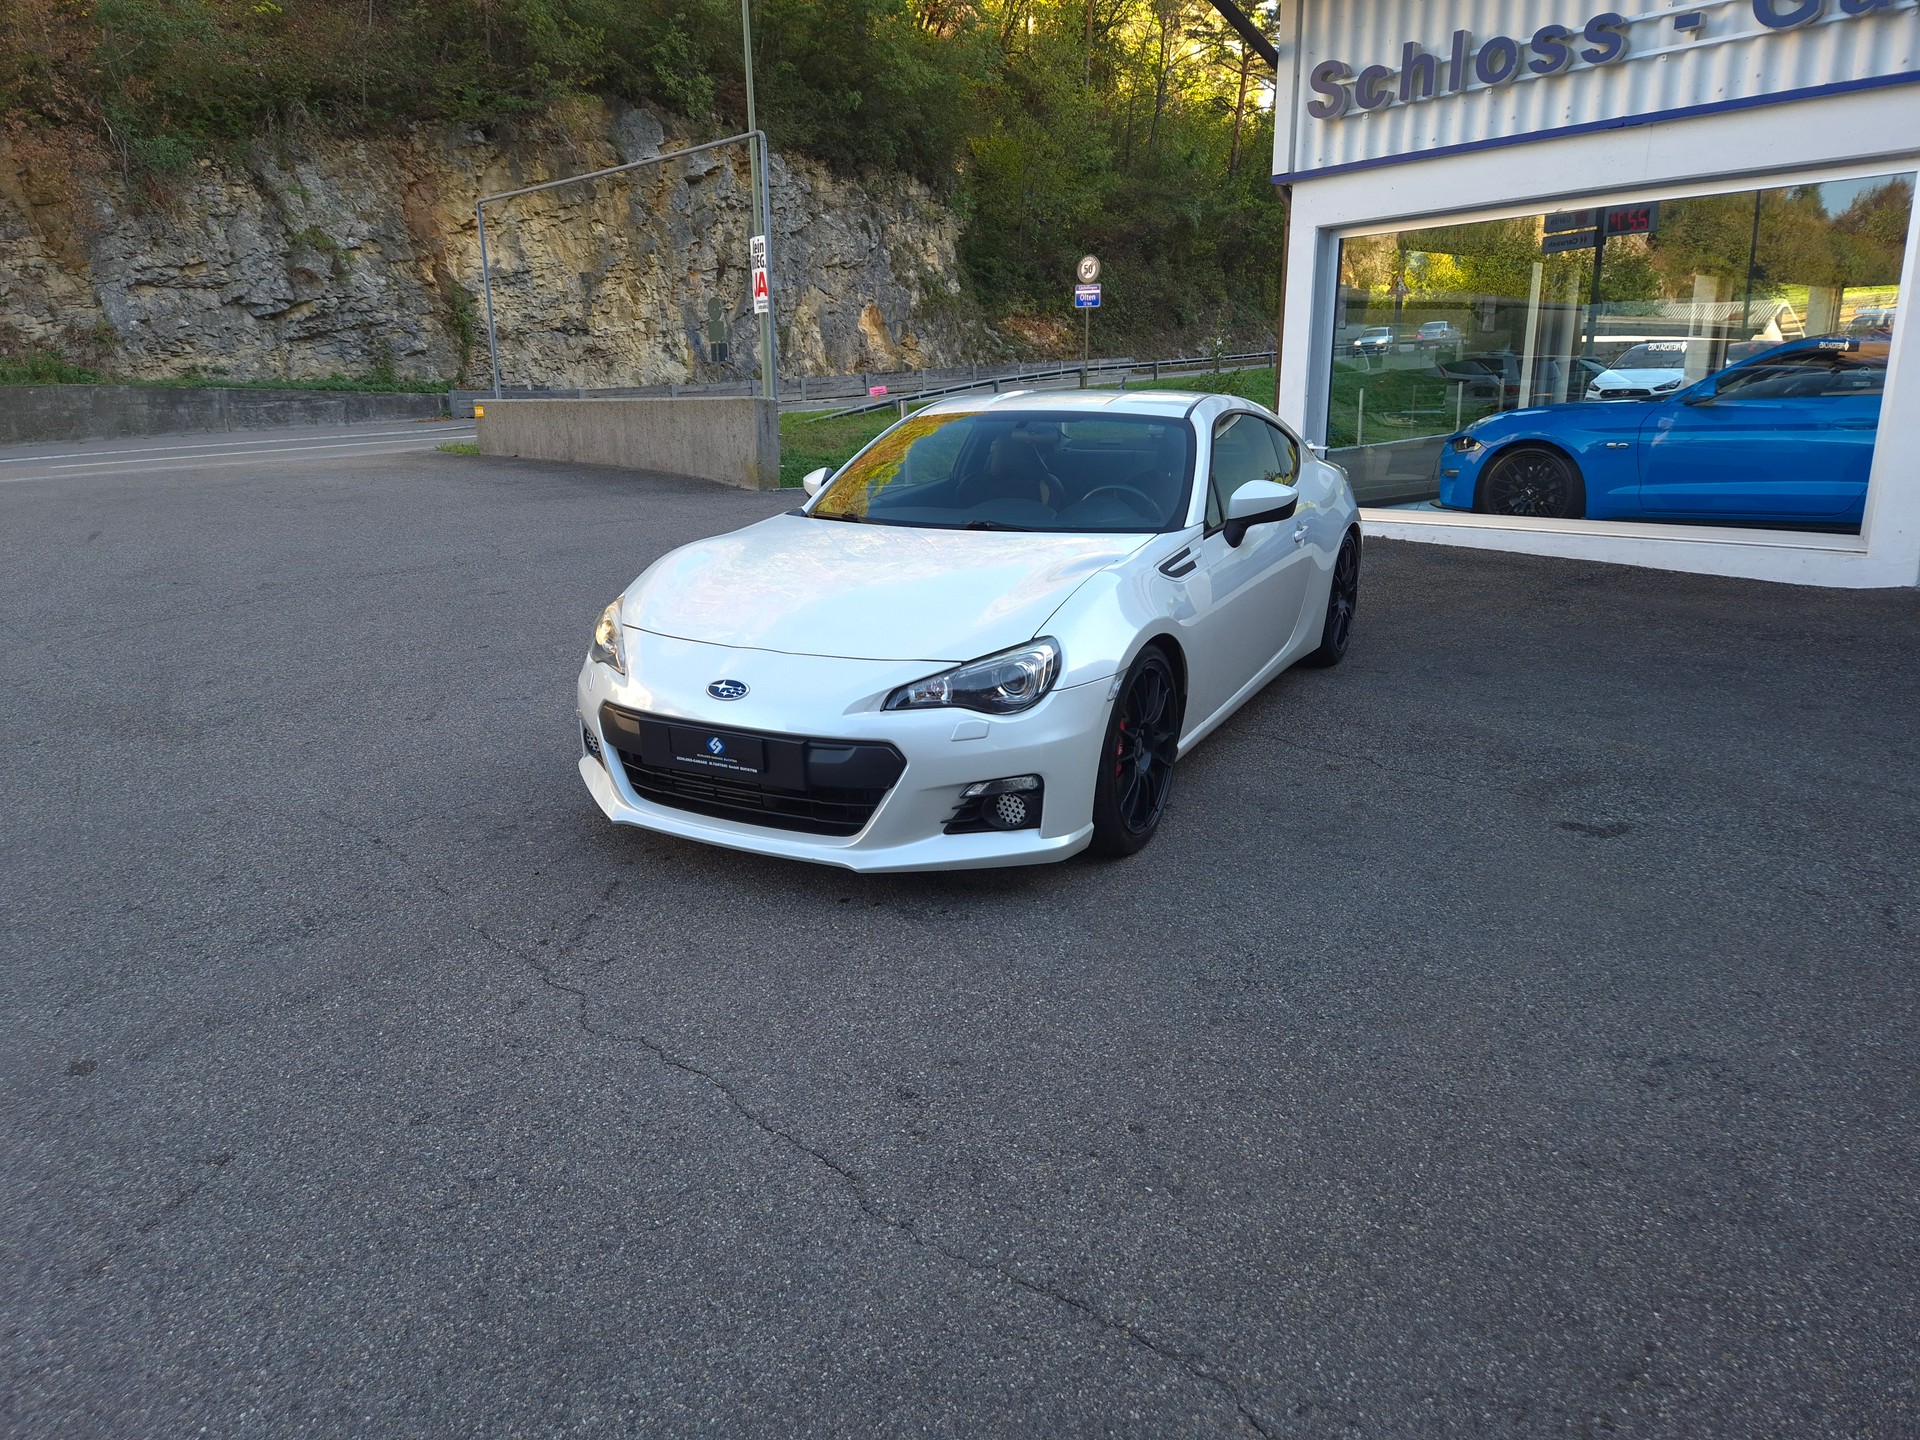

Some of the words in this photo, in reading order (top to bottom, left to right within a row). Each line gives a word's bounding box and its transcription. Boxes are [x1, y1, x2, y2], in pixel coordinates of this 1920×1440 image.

[1307, 12, 1628, 120] Schloss
[1083, 264, 1093, 275] 50
[1080, 294, 1096, 302] Olten
